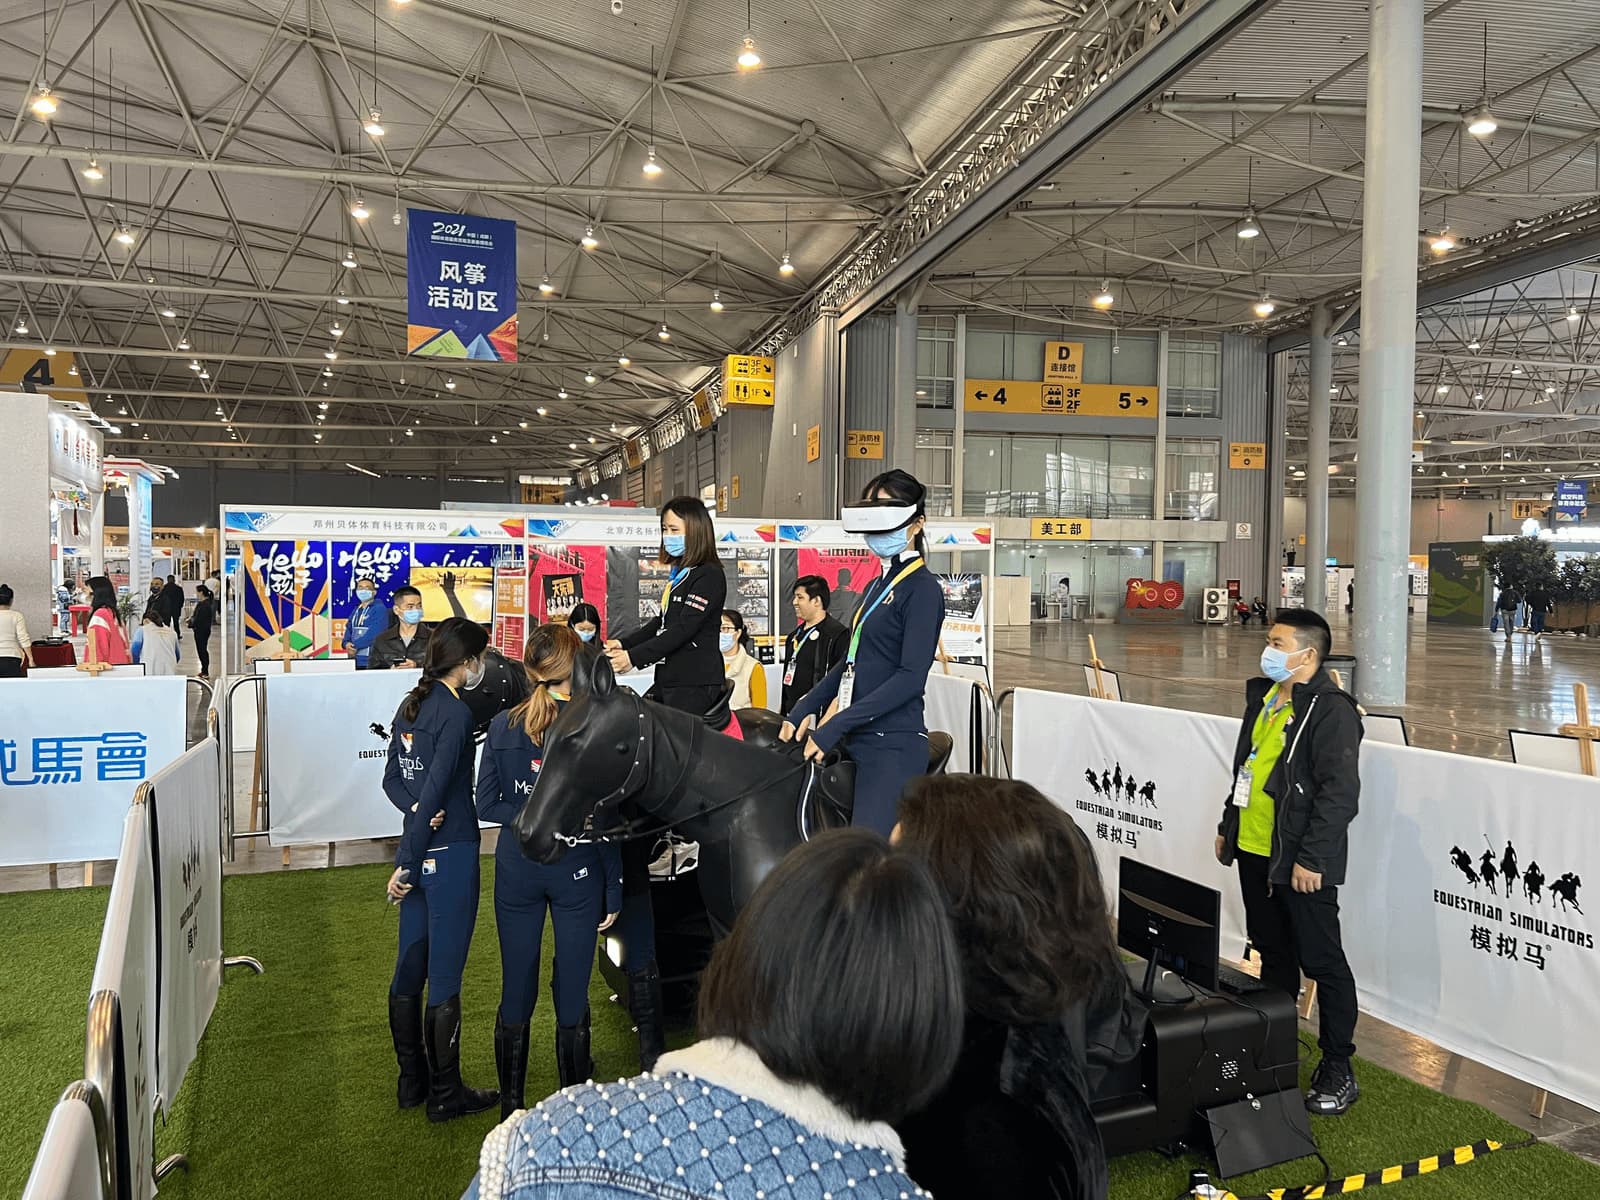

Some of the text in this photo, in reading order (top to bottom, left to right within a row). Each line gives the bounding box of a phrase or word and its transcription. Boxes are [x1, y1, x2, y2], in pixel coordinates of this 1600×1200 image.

[432, 221, 466, 237] 2021
[439, 260, 487, 285] 风筝
[427, 285, 499, 312] 活动区
[1058, 346, 1071, 360] D
[750, 359, 762, 367] 3F
[1050, 363, 1076, 373] 连接馆
[23, 358, 54, 387] 4
[750, 367, 762, 376] 2F
[751, 388, 761, 396] 1F
[993, 387, 1008, 405] 4
[1066, 388, 1081, 398] 3F
[1066, 400, 1081, 410] 2F
[1118, 392, 1131, 410] 5
[313, 518, 449, 532] 郑州贝体体育科技有限公司
[1041, 522, 1082, 536] 美工部
[251, 543, 323, 577] Hello
[338, 541, 403, 571] Hello
[358, 750, 388, 759] EQUEST
[514, 779, 533, 795] Me
[1075, 799, 1163, 831] EQUESTRIAN SIMULATORS
[1096, 821, 1137, 849] 模拟马
[1433, 889, 1594, 949] EQUESTRIAN SIMULATORS
[1470, 924, 1546, 971] 模拟马
